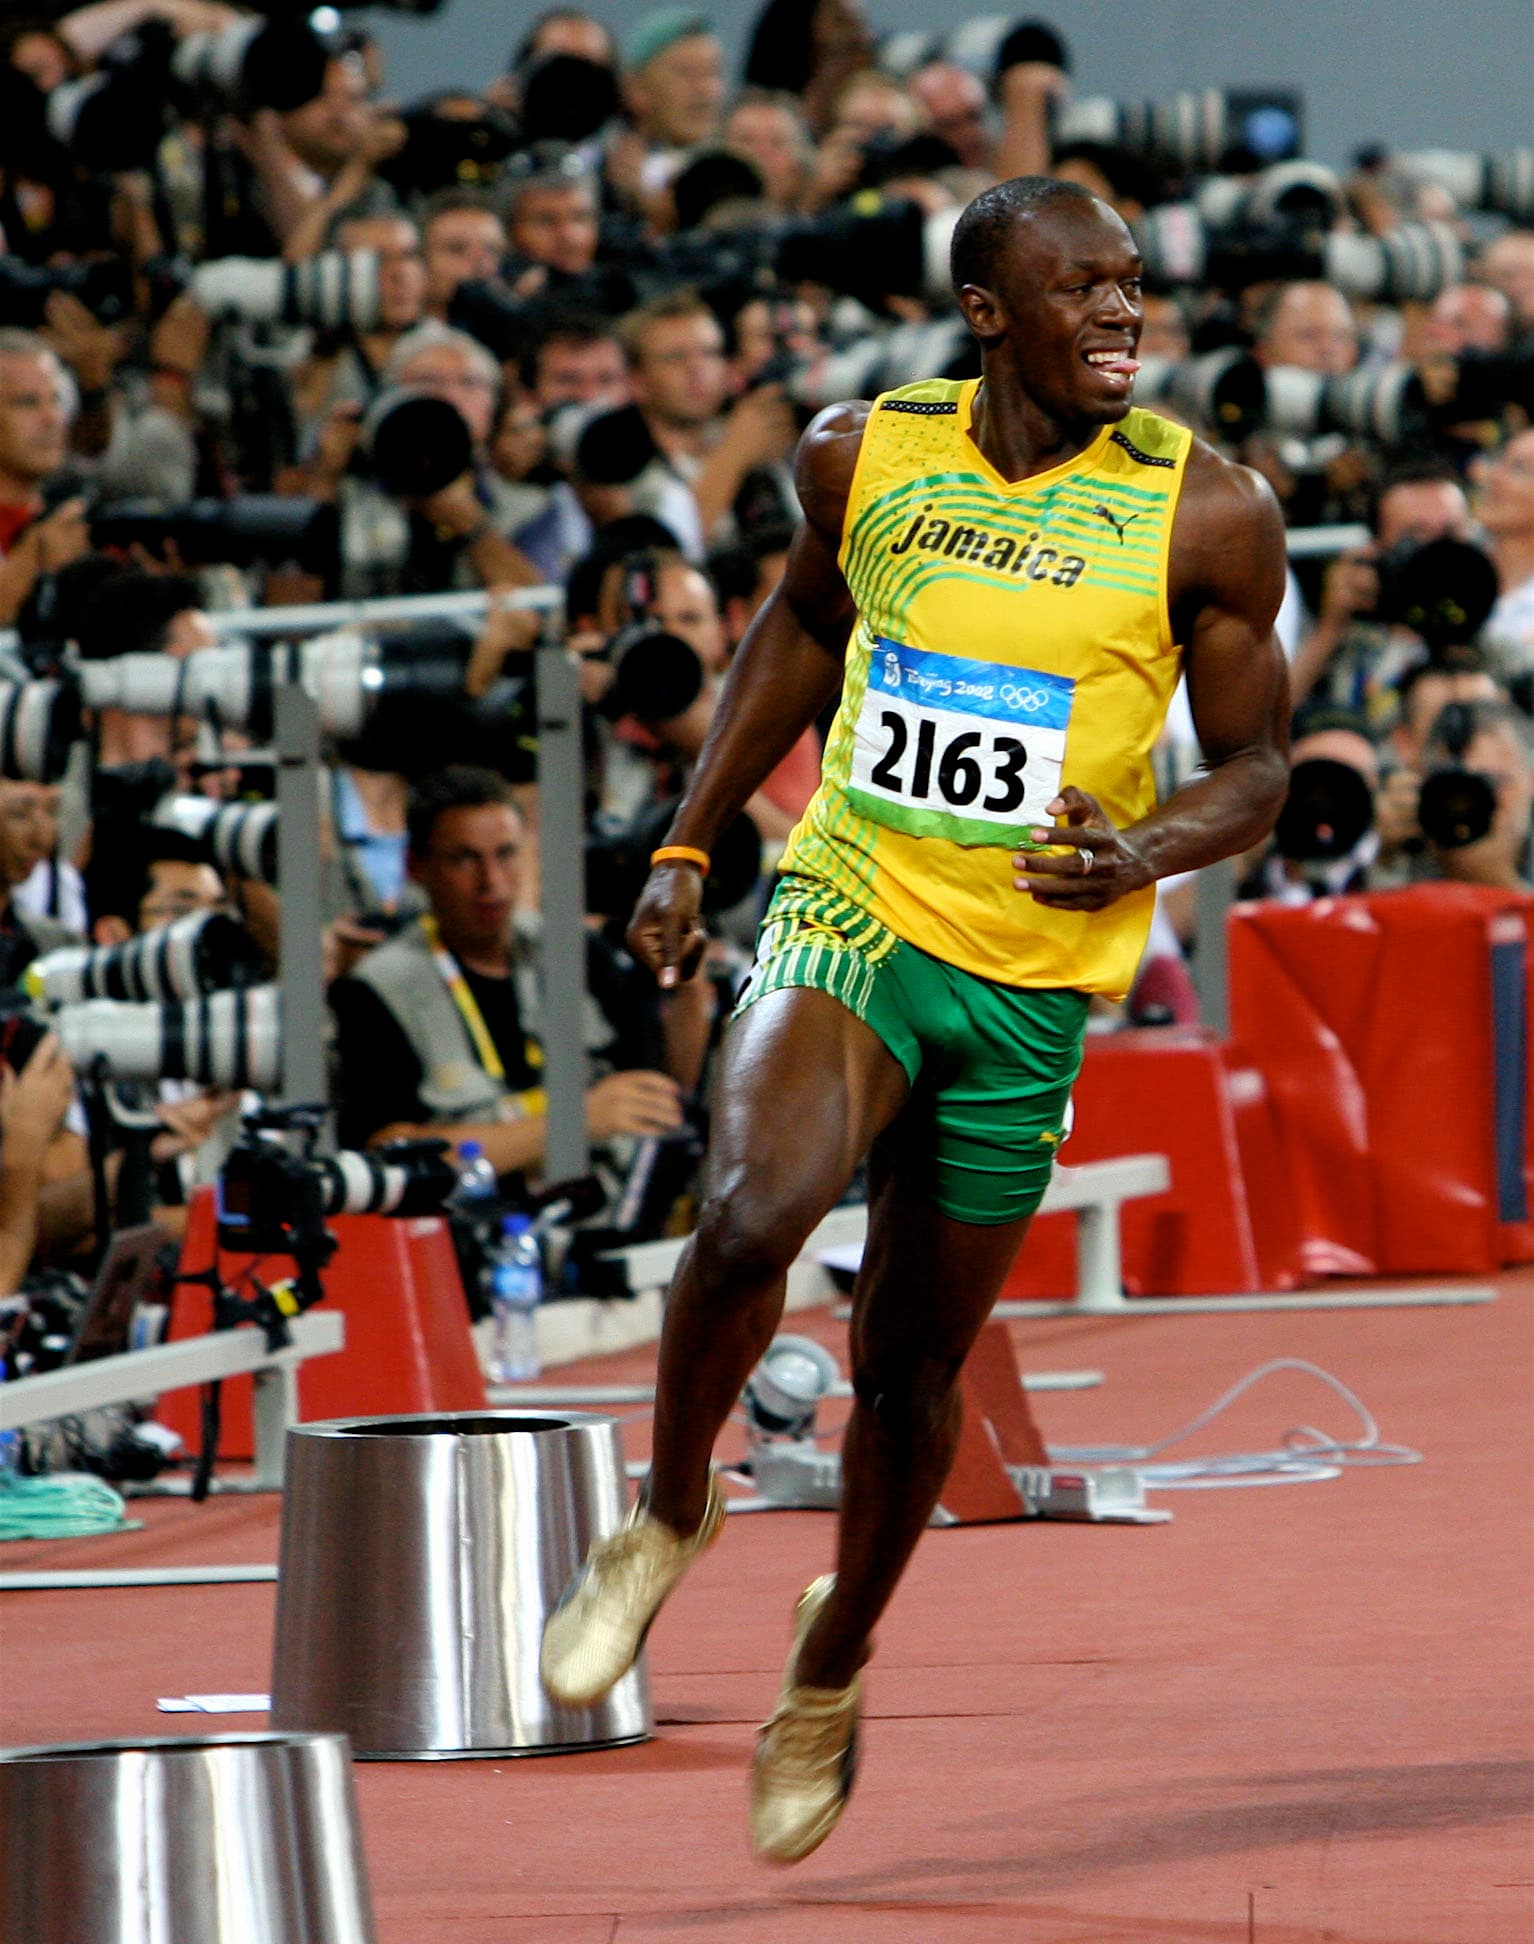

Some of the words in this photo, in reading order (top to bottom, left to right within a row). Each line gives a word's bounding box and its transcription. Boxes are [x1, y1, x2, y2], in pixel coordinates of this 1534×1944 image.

[891, 503, 1086, 587] jamaica
[904, 668, 952, 697] Beijing
[954, 680, 995, 700] 2008
[871, 711, 1027, 812] 2163
